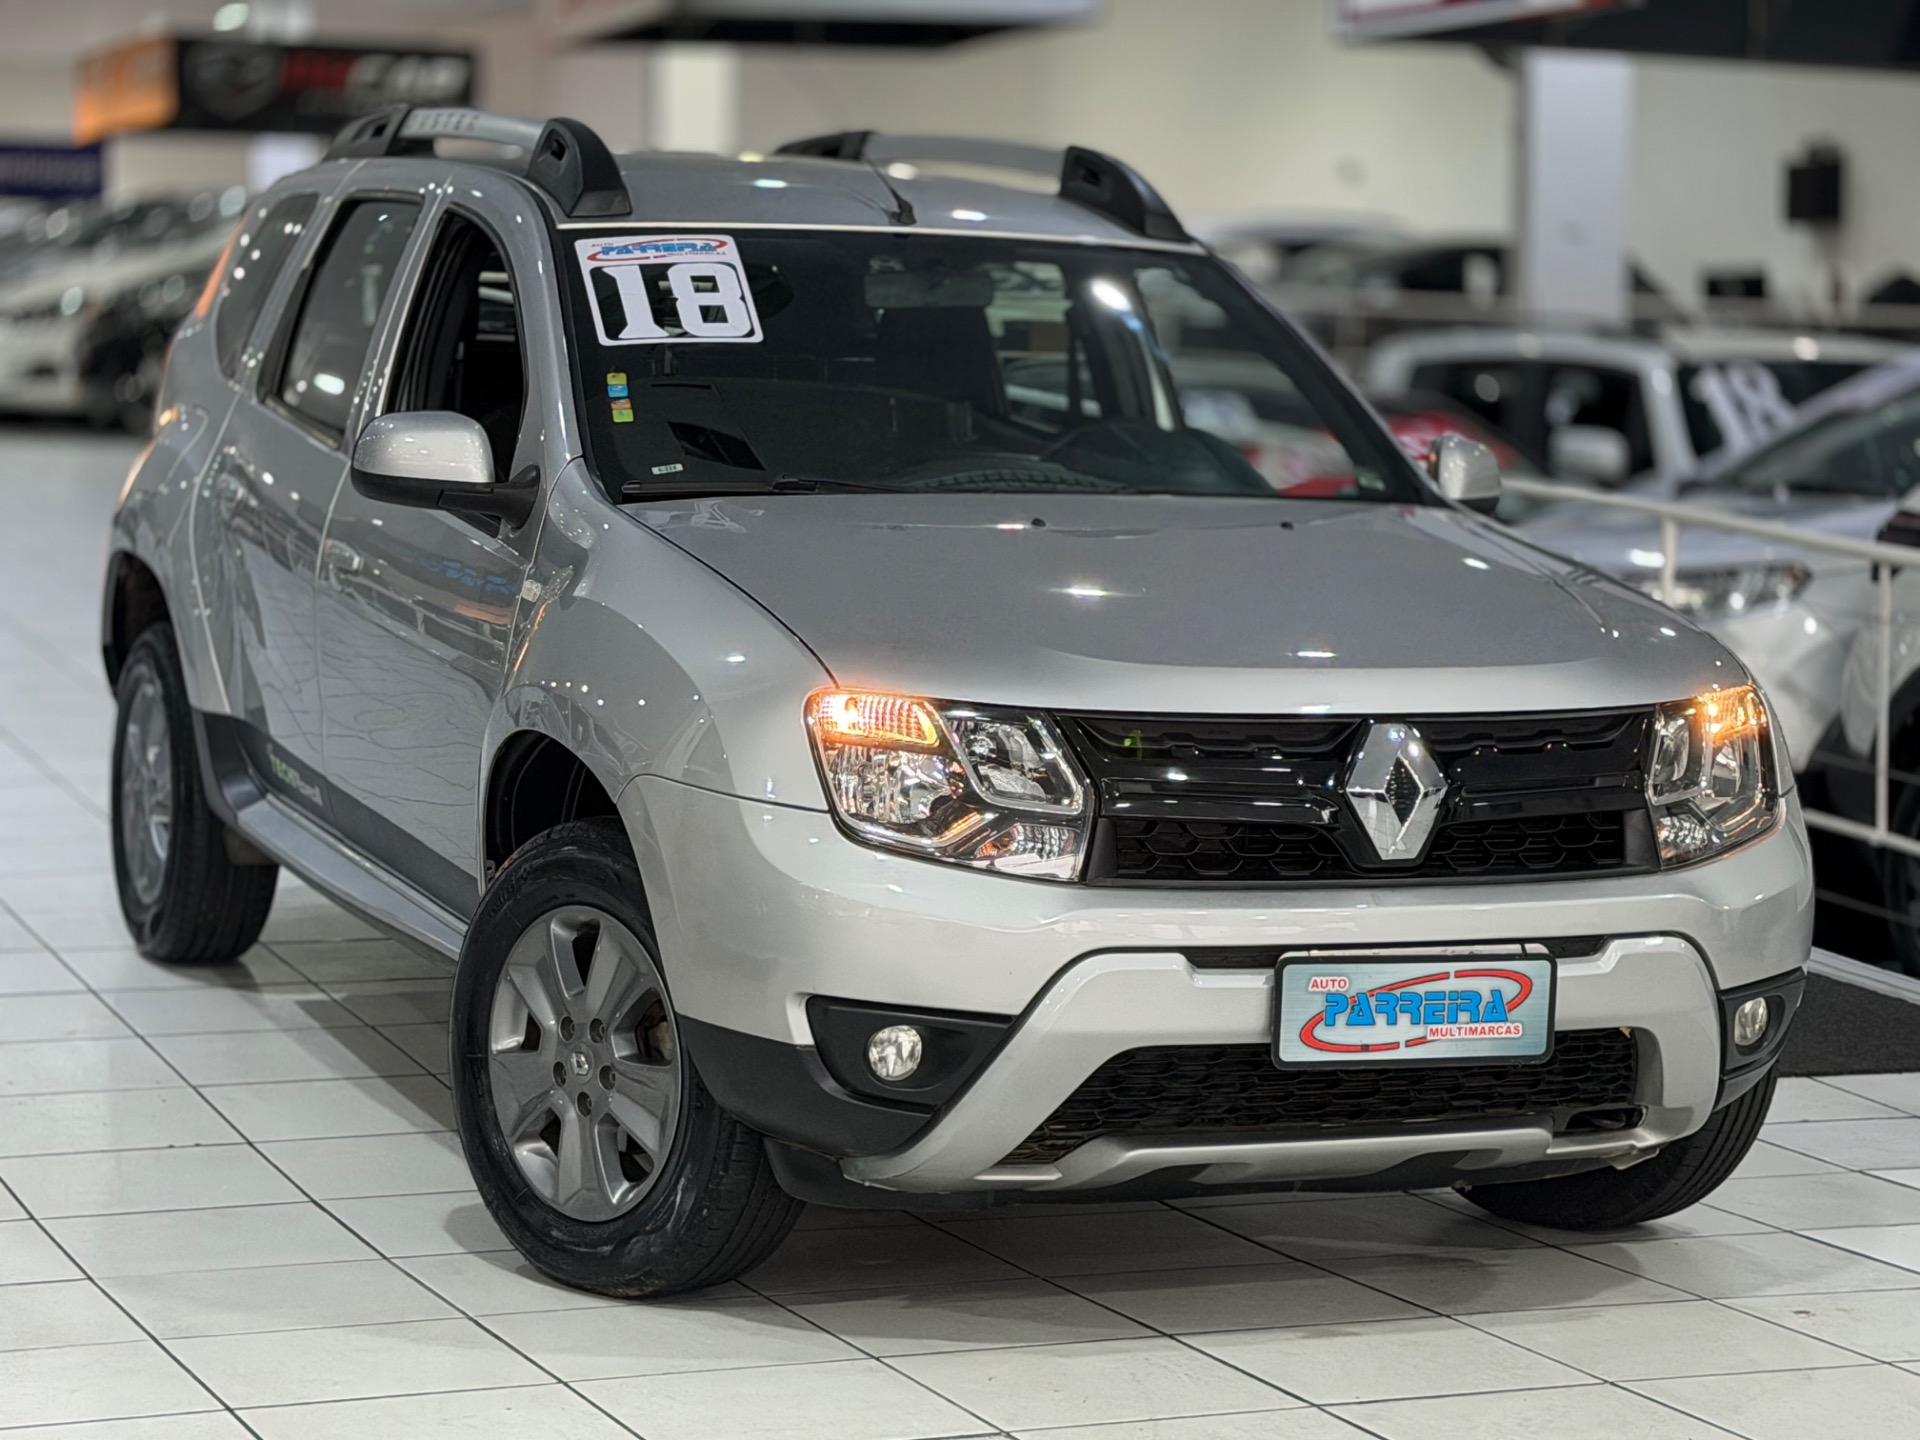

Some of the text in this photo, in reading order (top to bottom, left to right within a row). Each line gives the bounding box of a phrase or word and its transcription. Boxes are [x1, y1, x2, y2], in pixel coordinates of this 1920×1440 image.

[601, 262, 752, 339] 18
[1310, 978, 1348, 990] AUTO
[1324, 989, 1509, 1027] PARREIRA
[1428, 1024, 1522, 1038] MULTIMARCAS
